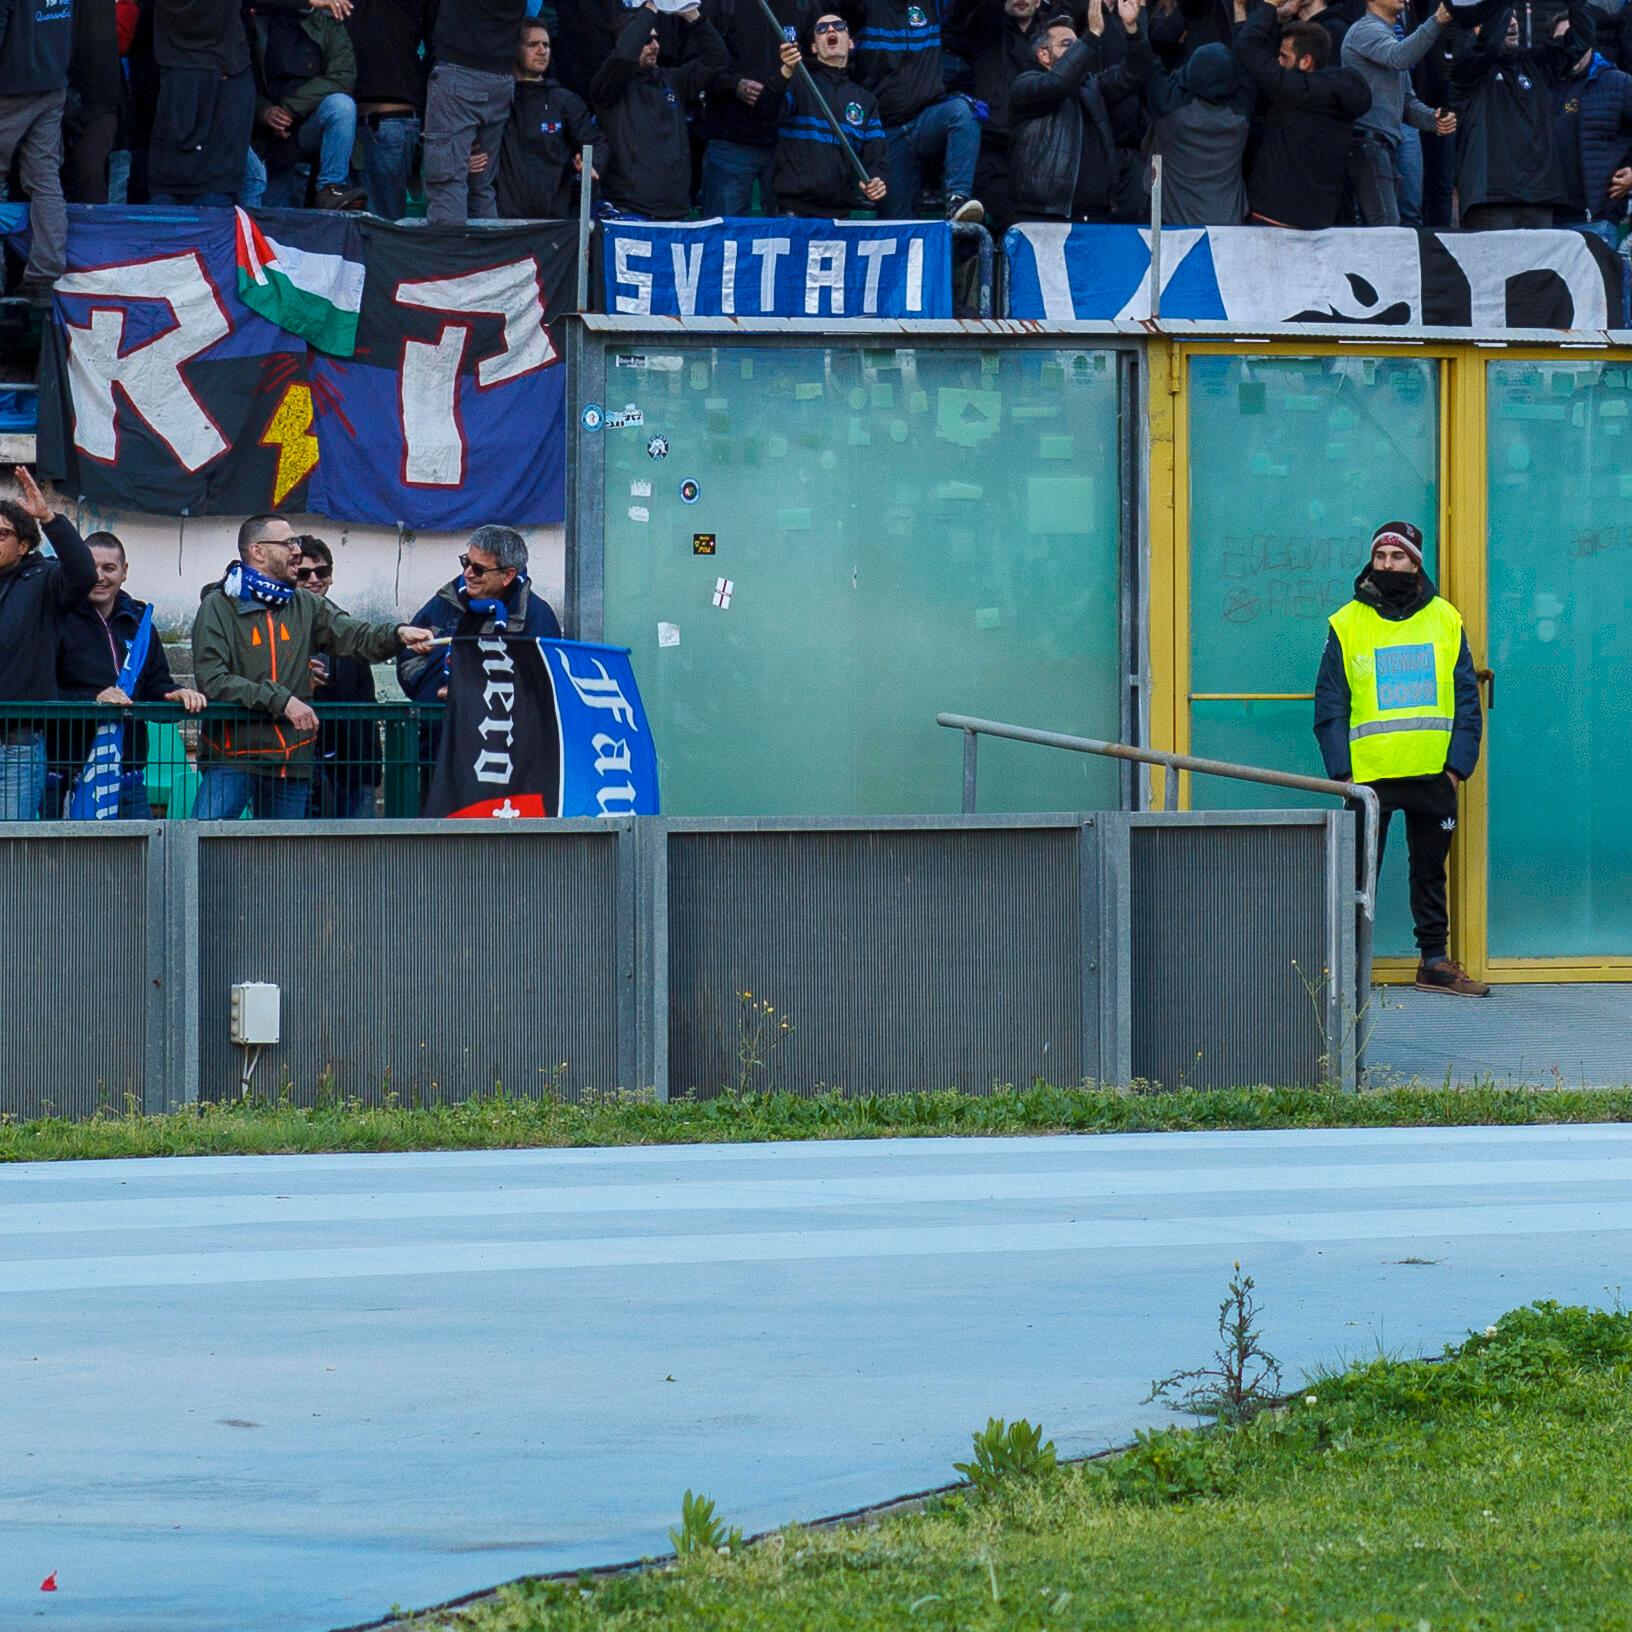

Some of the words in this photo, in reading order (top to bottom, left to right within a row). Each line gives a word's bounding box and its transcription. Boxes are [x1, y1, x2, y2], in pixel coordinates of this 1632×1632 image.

[614, 236, 925, 317] SVITATI
[52, 247, 234, 474] R
[473, 636, 515, 785] nero
